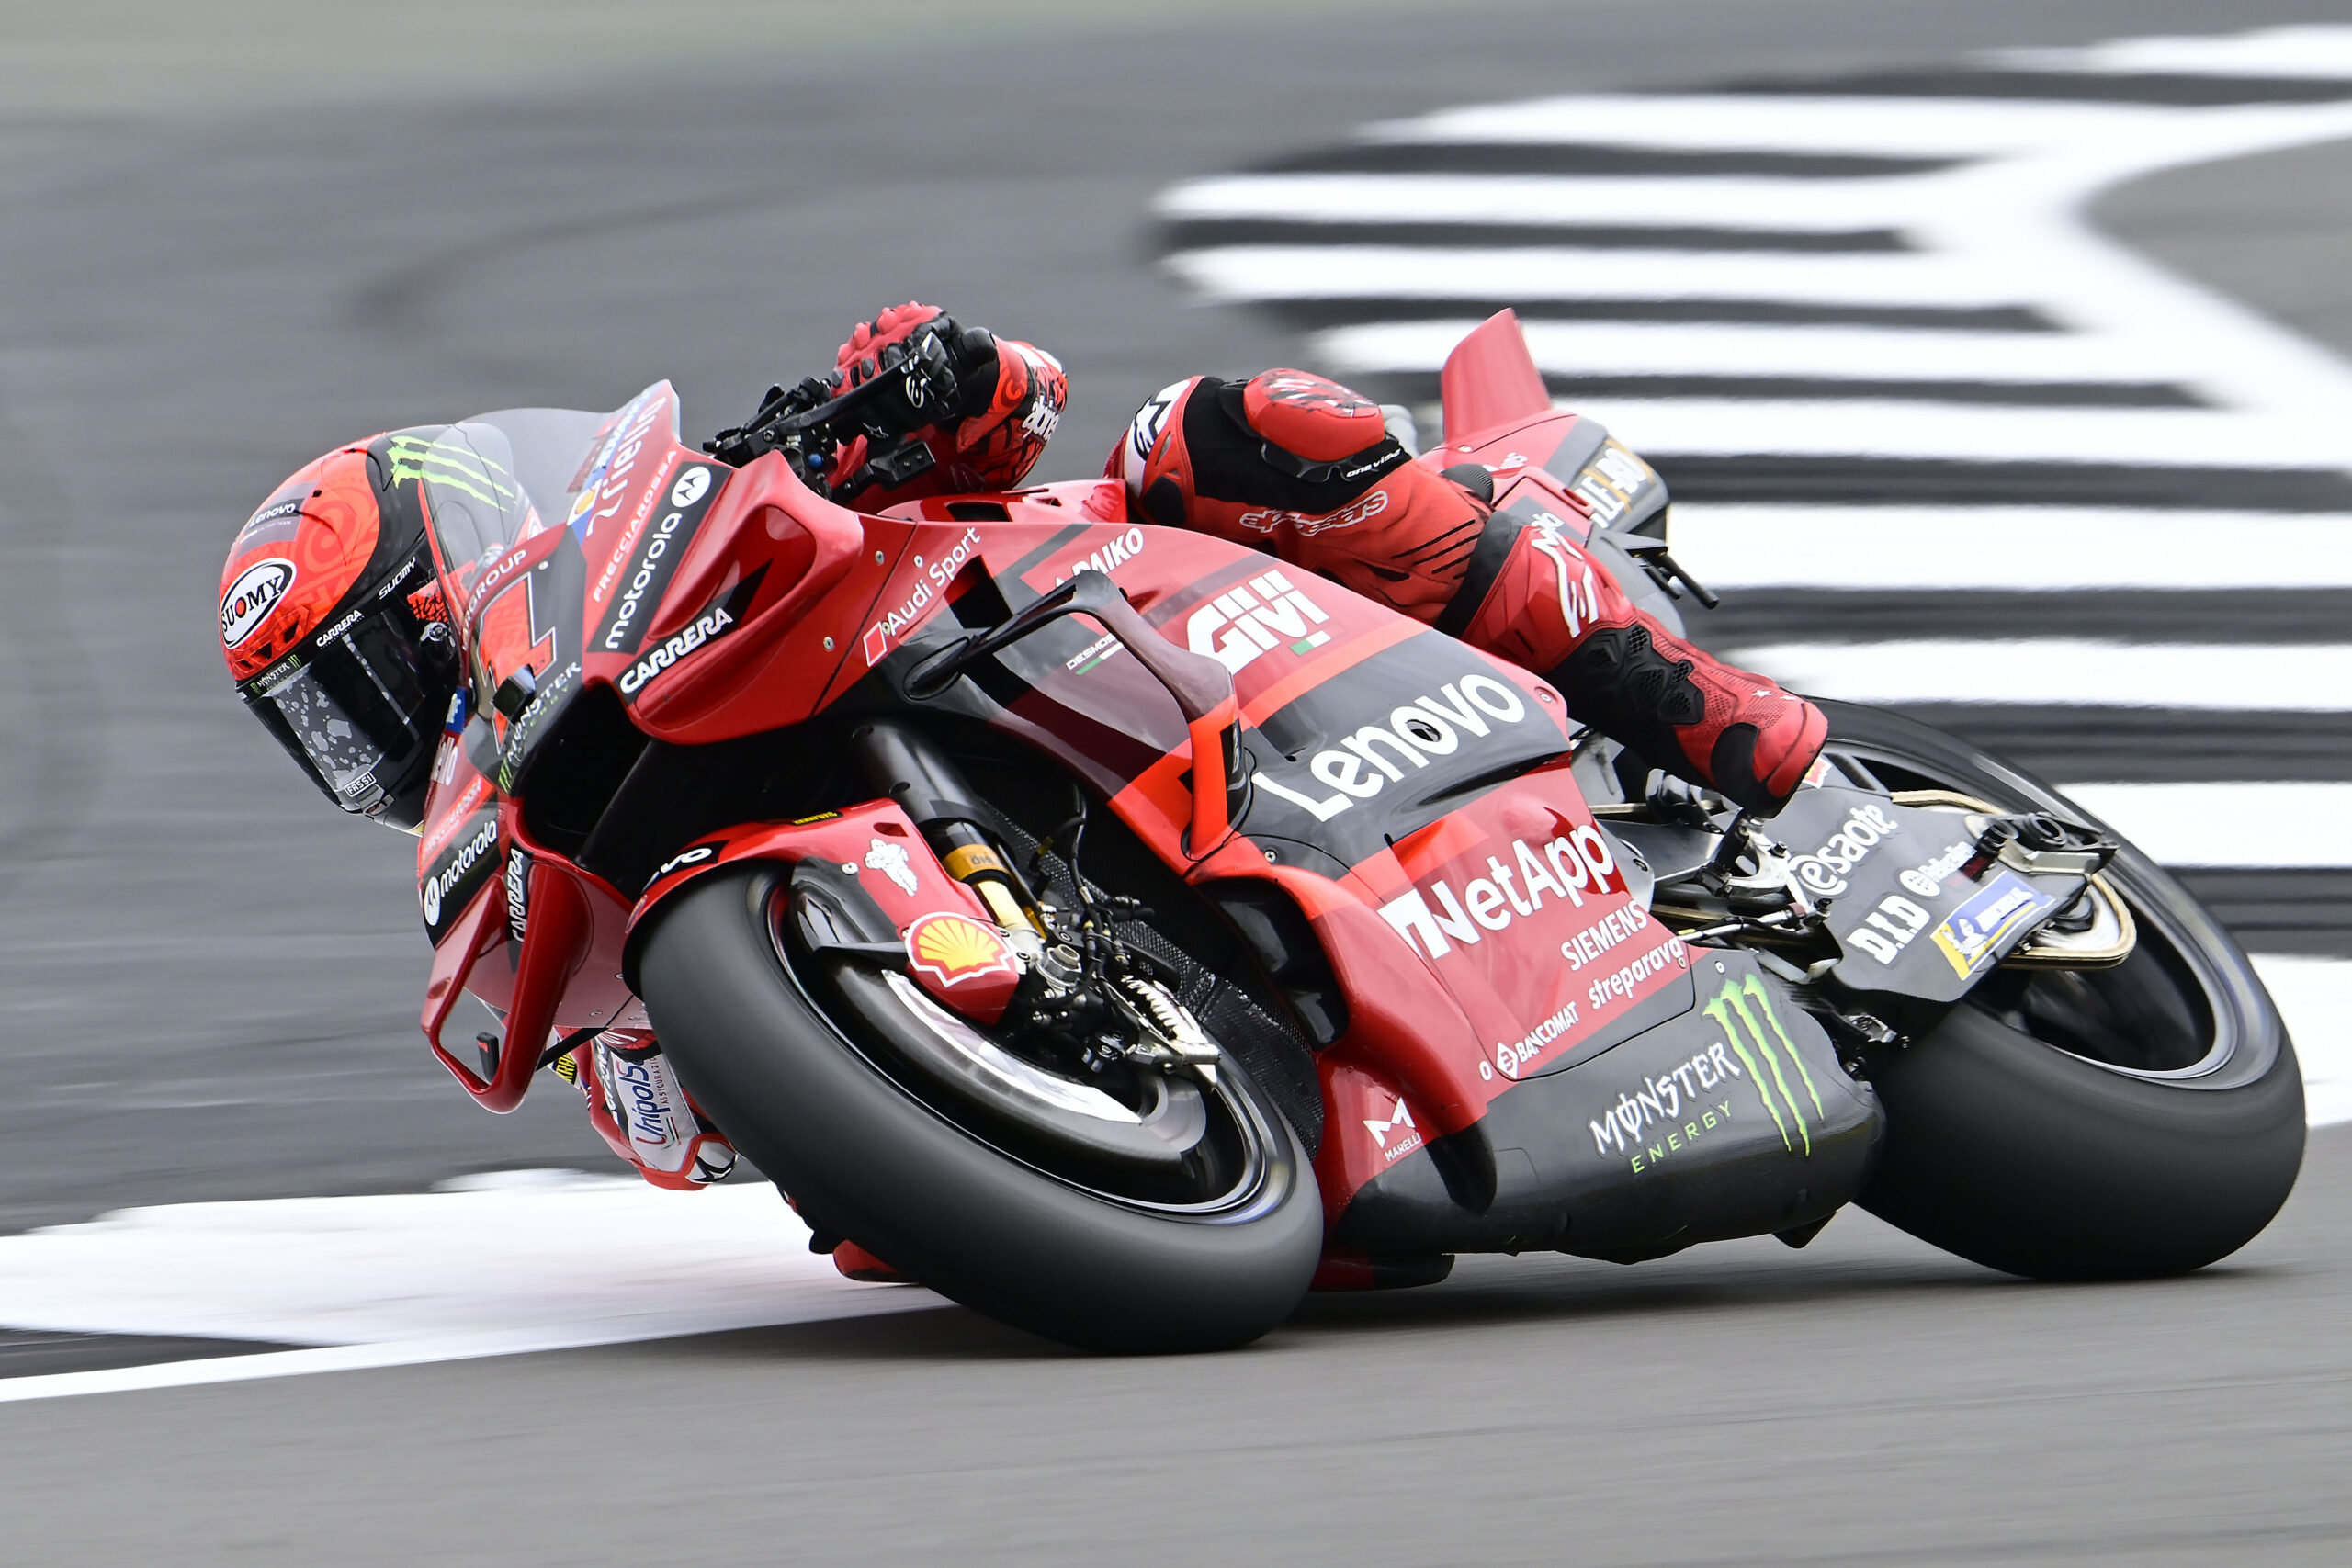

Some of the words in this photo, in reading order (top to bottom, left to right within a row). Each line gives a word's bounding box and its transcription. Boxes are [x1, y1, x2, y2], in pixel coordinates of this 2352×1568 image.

[249, 502, 296, 527] Lenovo
[221, 575, 283, 633] SUOMY
[378, 556, 416, 600] SUOMY
[468, 549, 527, 611] GROUP
[605, 513, 683, 649] motorola
[886, 579, 933, 636] Audi
[929, 526, 981, 589] Sport
[316, 609, 363, 648] CARRERA
[620, 607, 734, 694] CARRERA
[1186, 569, 1330, 675] GIVI
[256, 661, 291, 688] MONSTER
[346, 774, 373, 795] FASSI
[1252, 673, 1526, 822] Lenovo
[439, 819, 497, 897] motorola
[507, 847, 524, 943] CARRERA
[1376, 824, 1615, 960] NetApp
[1560, 897, 1648, 972] SIEMENS
[1589, 936, 1684, 1010] streparava
[1514, 1001, 1580, 1063] BANCOMAT
[1589, 1041, 1742, 1156] MONSTER
[1385, 1133, 1422, 1162] MARELLI
[1631, 1100, 1734, 1176] ENERGY
